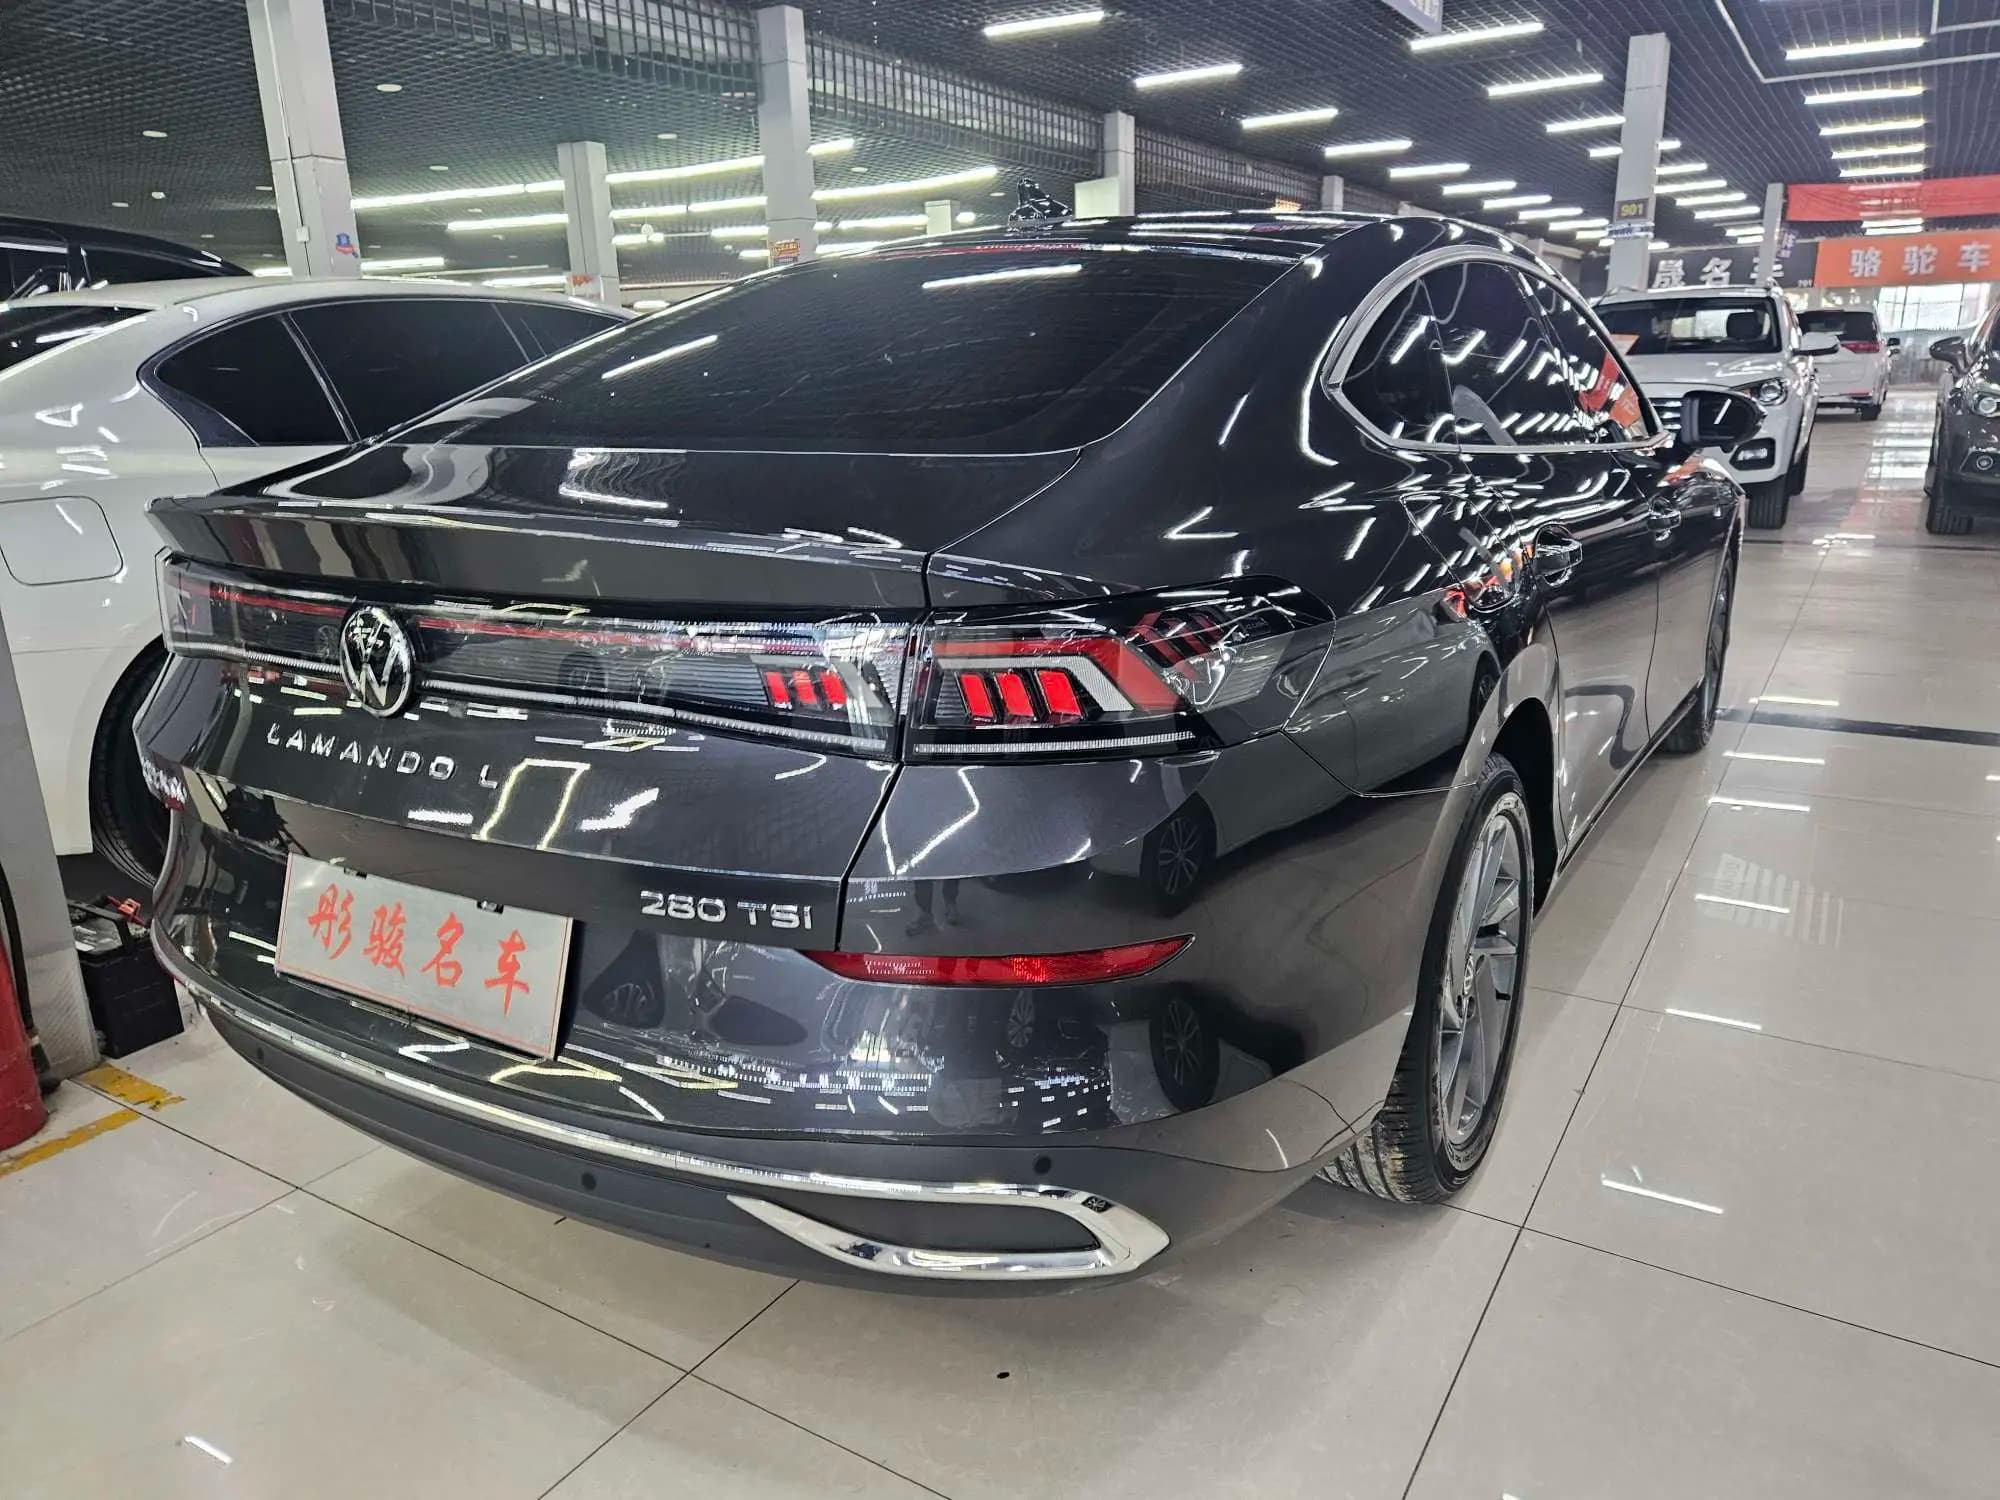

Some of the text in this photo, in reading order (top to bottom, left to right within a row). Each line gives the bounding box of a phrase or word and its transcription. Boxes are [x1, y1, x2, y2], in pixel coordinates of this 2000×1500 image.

[1620, 203, 1644, 217] 901
[1849, 241, 1992, 279] 骆驼车
[266, 722, 499, 790] LAMANDO L
[640, 890, 813, 930] 280 TSI
